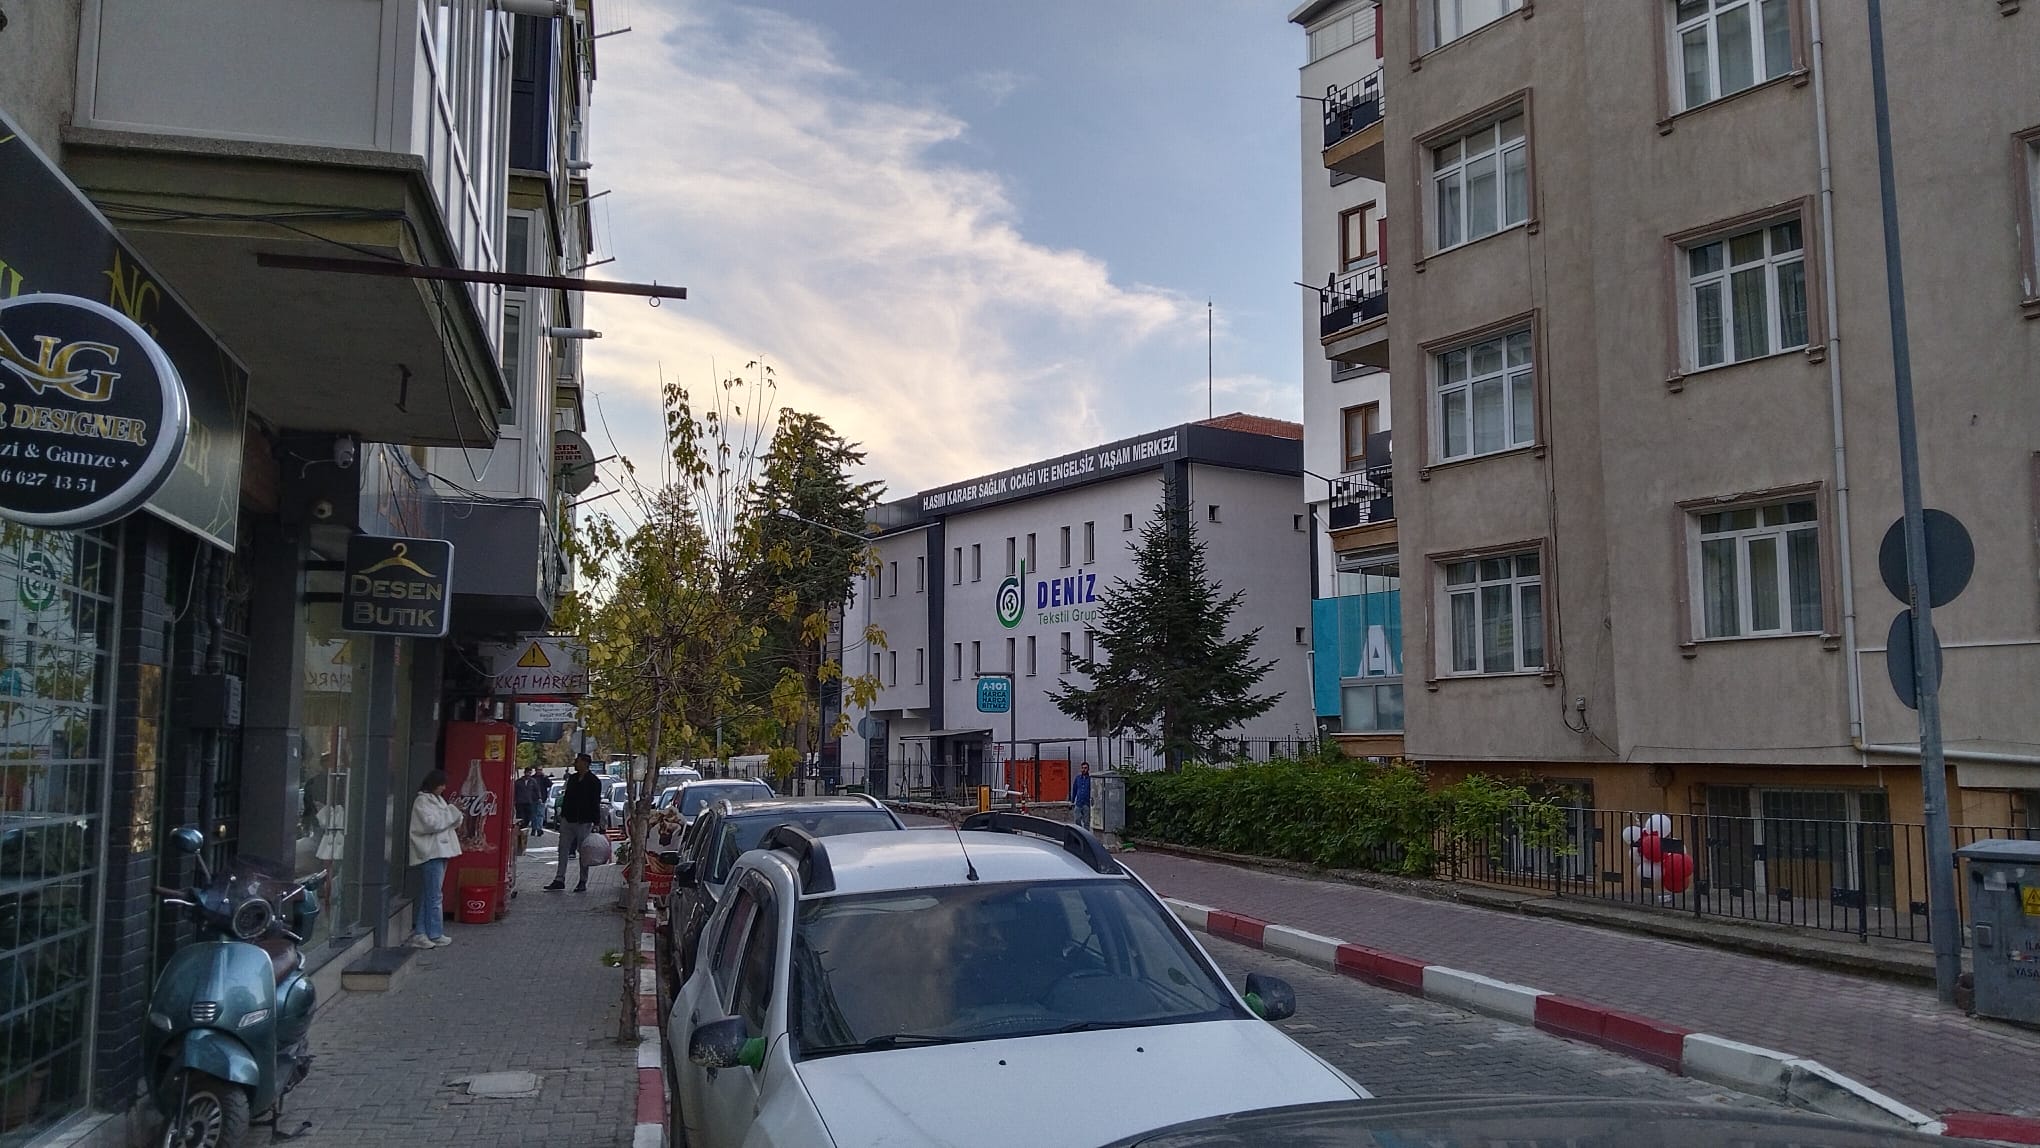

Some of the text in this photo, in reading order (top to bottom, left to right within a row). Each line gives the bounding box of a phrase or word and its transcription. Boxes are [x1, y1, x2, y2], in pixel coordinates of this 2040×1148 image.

[10, 404, 147, 446] DESIGNER
[24, 443, 40, 458] &
[46, 445, 116, 468] Gamze
[946, 485, 977, 506] KARAER
[978, 478, 1007, 498] SAĞLIK
[1010, 468, 1036, 491] OCAĞI
[1038, 466, 1049, 484] VE
[1051, 453, 1094, 481] ENGELSİZ
[1098, 446, 1130, 471] YAŞAM
[1133, 431, 1178, 462] MERKEZİ
[15, 471, 48, 486] 627
[350, 574, 443, 601] DESEN
[1037, 568, 1096, 610] DENİZ
[1037, 609, 1069, 625] Tekstil
